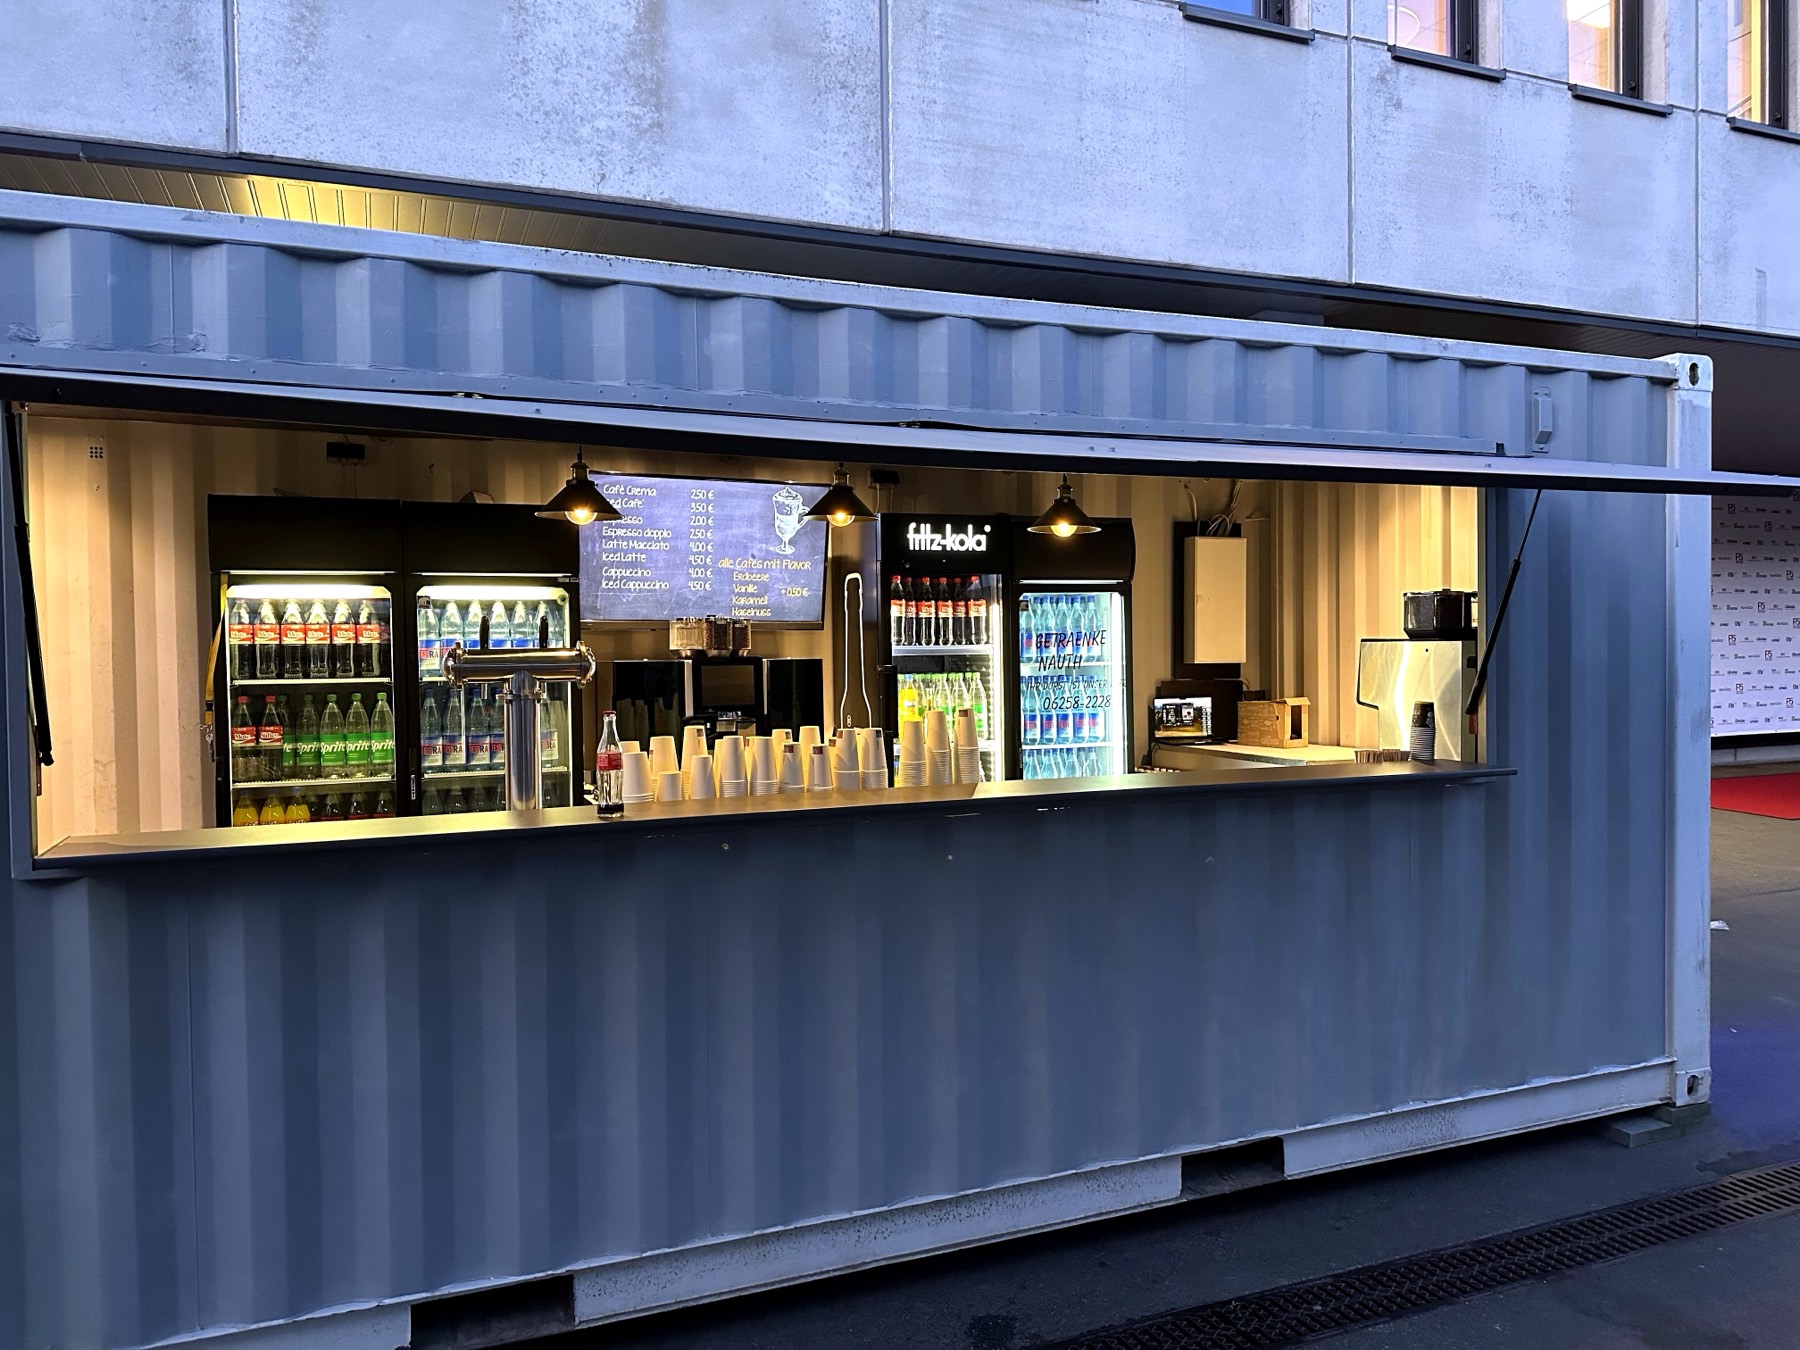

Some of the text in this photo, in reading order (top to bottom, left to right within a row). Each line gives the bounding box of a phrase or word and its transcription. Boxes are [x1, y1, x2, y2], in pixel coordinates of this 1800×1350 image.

[626, 485, 657, 497] Crema
[707, 490, 715, 500] €
[708, 503, 715, 513] €
[708, 516, 715, 526] €
[602, 526, 643, 538] Espresso
[643, 528, 672, 540] doppio
[707, 529, 714, 539] €
[907, 522, 987, 551] fritz-kola
[602, 539, 628, 549] Latte
[629, 540, 670, 550] Macciato
[706, 543, 714, 552] €
[602, 551, 620, 561] Iced
[621, 552, 646, 562] Latte
[706, 555, 713, 565] €
[718, 558, 734, 568] alle
[763, 559, 781, 569] mit
[602, 566, 651, 580] Cappuccino
[706, 568, 713, 578] €
[733, 571, 770, 581] Erdbeere
[601, 579, 620, 589] Iced
[620, 579, 670, 592] Cappuccino
[705, 581, 712, 591] €
[733, 584, 758, 593] Vanille
[802, 587, 809, 597] €
[731, 606, 772, 617] Haselnuss
[1035, 630, 1107, 650] GETRAENKE
[1038, 654, 1083, 672] NAUTH
[1043, 695, 1111, 711] 06258-2228
